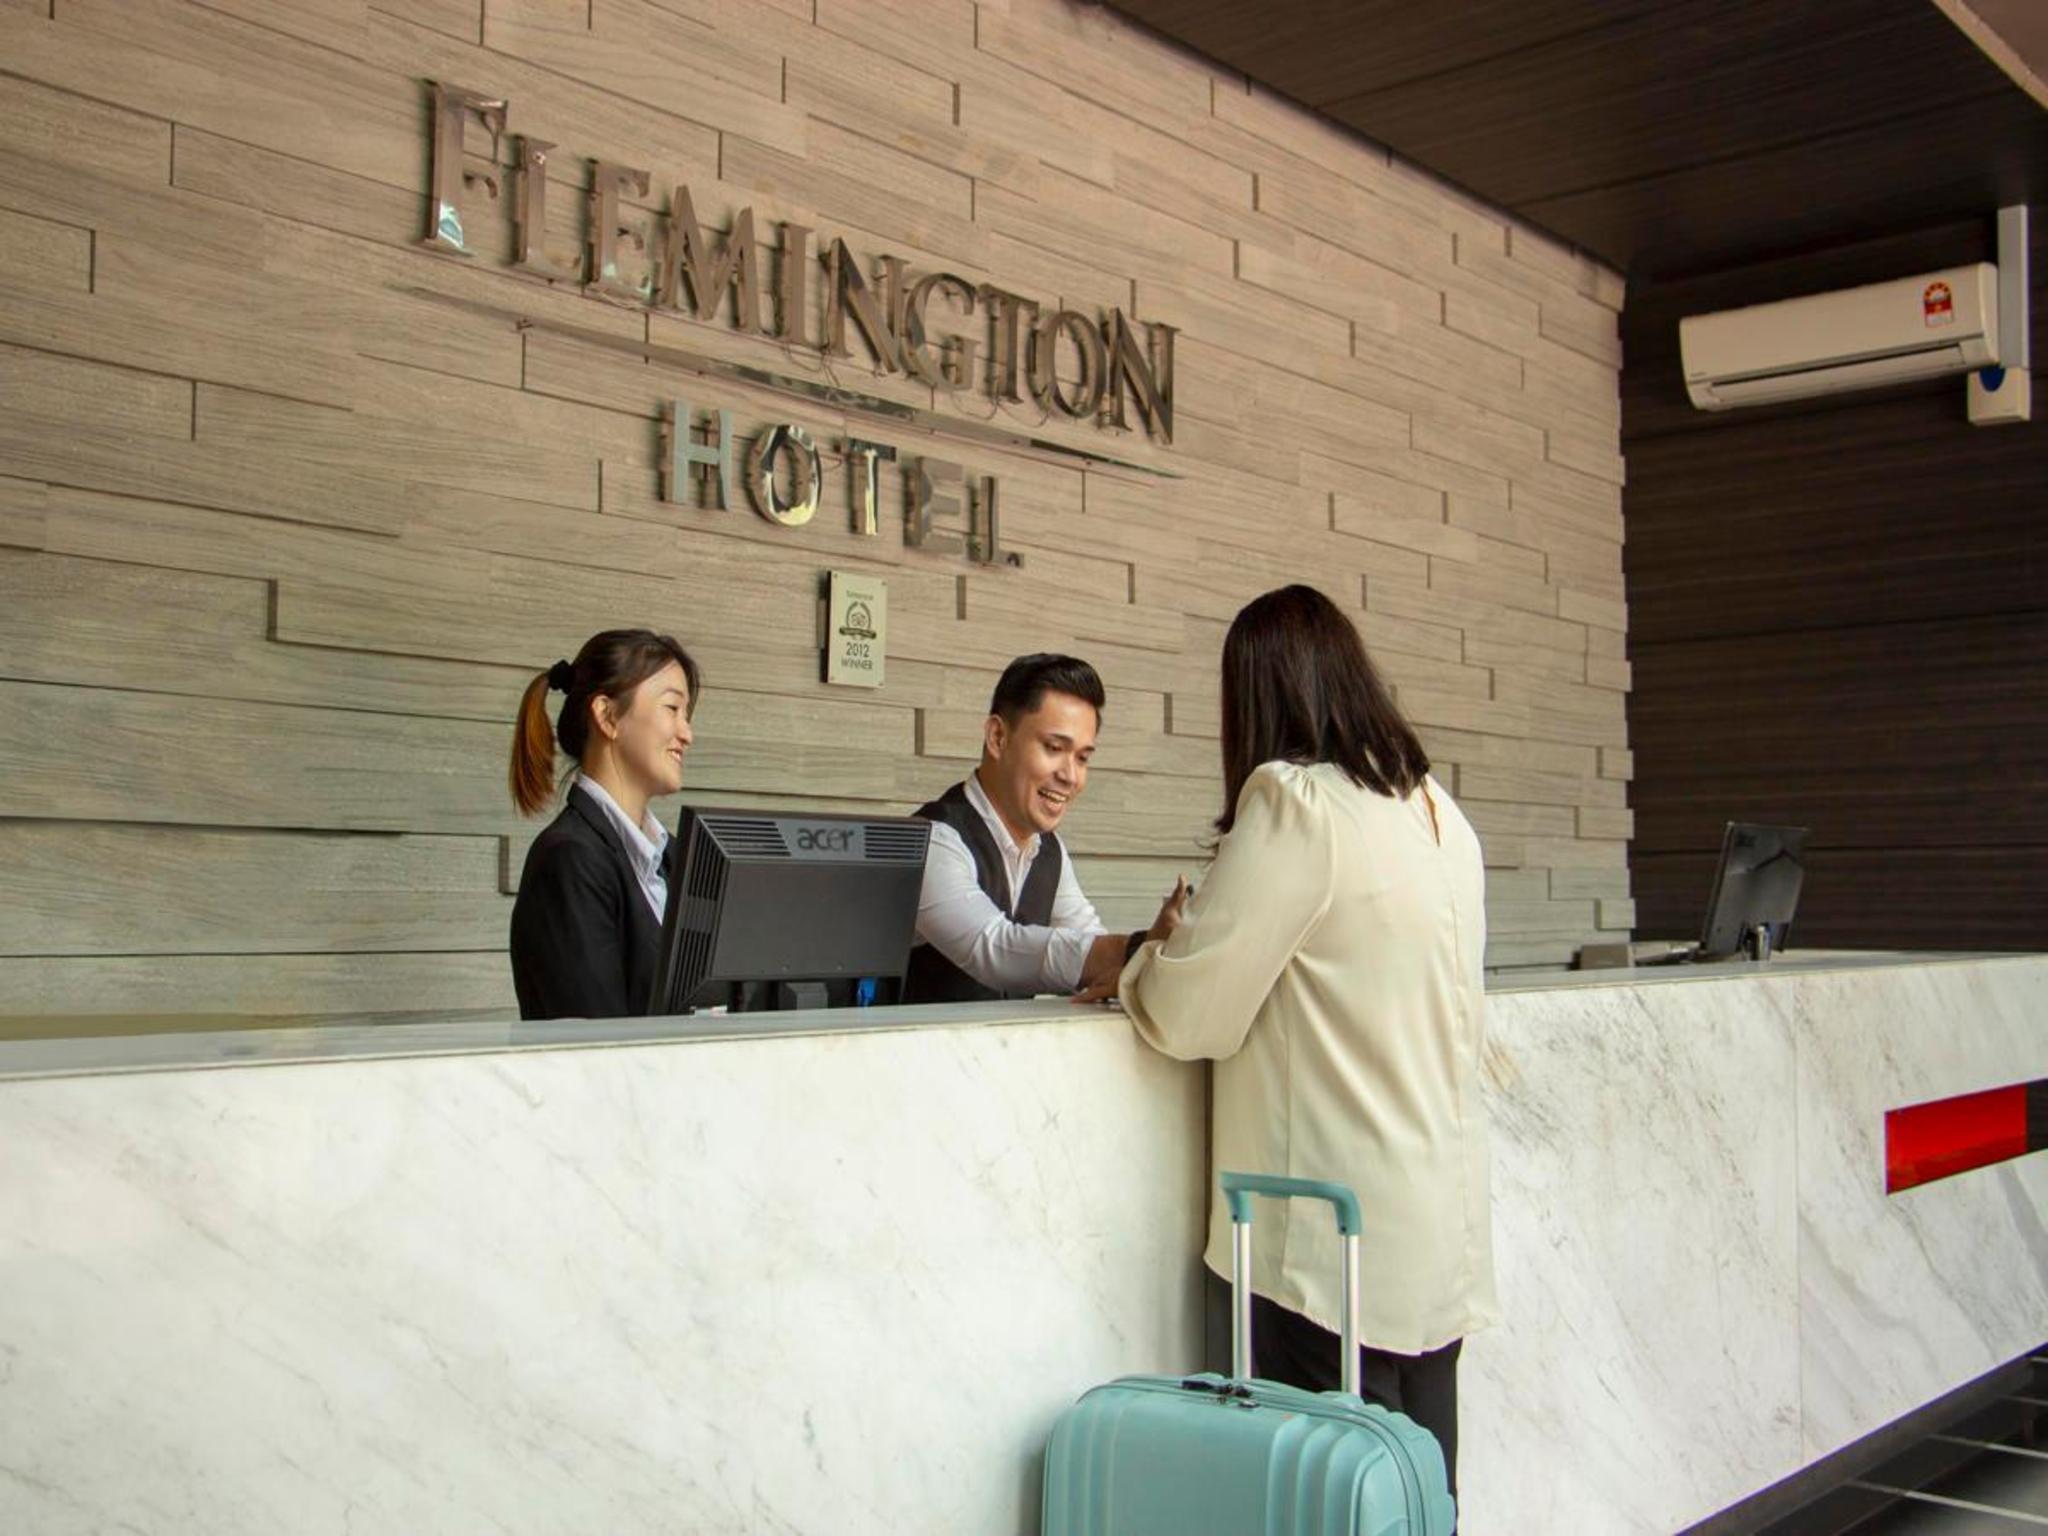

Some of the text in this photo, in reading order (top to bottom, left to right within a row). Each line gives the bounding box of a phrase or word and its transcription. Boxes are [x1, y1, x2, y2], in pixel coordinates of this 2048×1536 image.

[421, 79, 1181, 444] FLEMINGTON
[659, 399, 1025, 567] HOTEL
[846, 641, 870, 658] 2012
[841, 658, 873, 670] WINNER
[797, 827, 854, 850] acer
